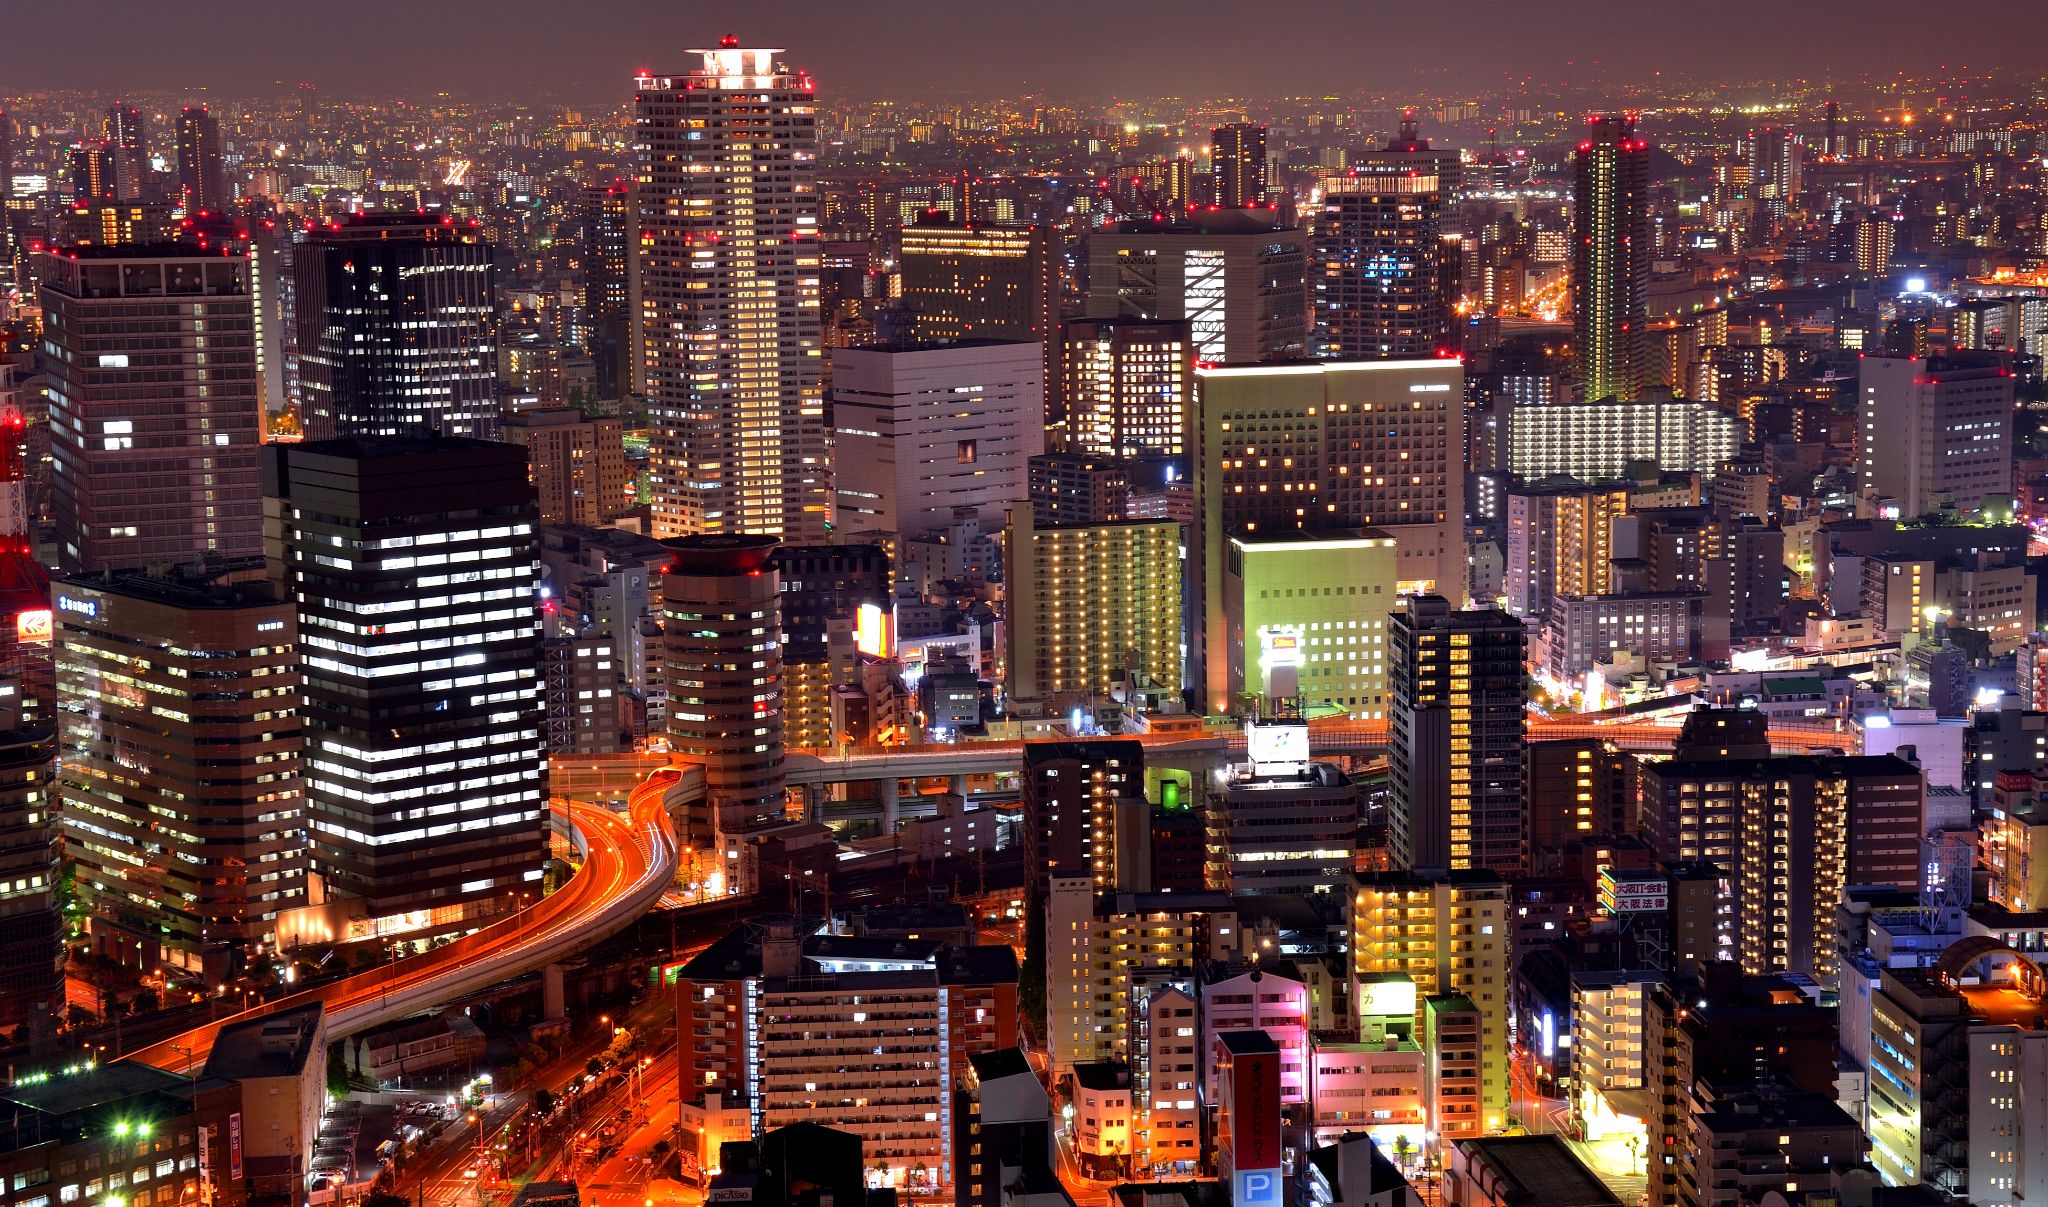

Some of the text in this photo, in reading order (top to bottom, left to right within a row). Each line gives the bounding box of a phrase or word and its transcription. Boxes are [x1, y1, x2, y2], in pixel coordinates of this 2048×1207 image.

[1618, 898, 1665, 909] 大阪法律
[1246, 1174, 1270, 1200] P
